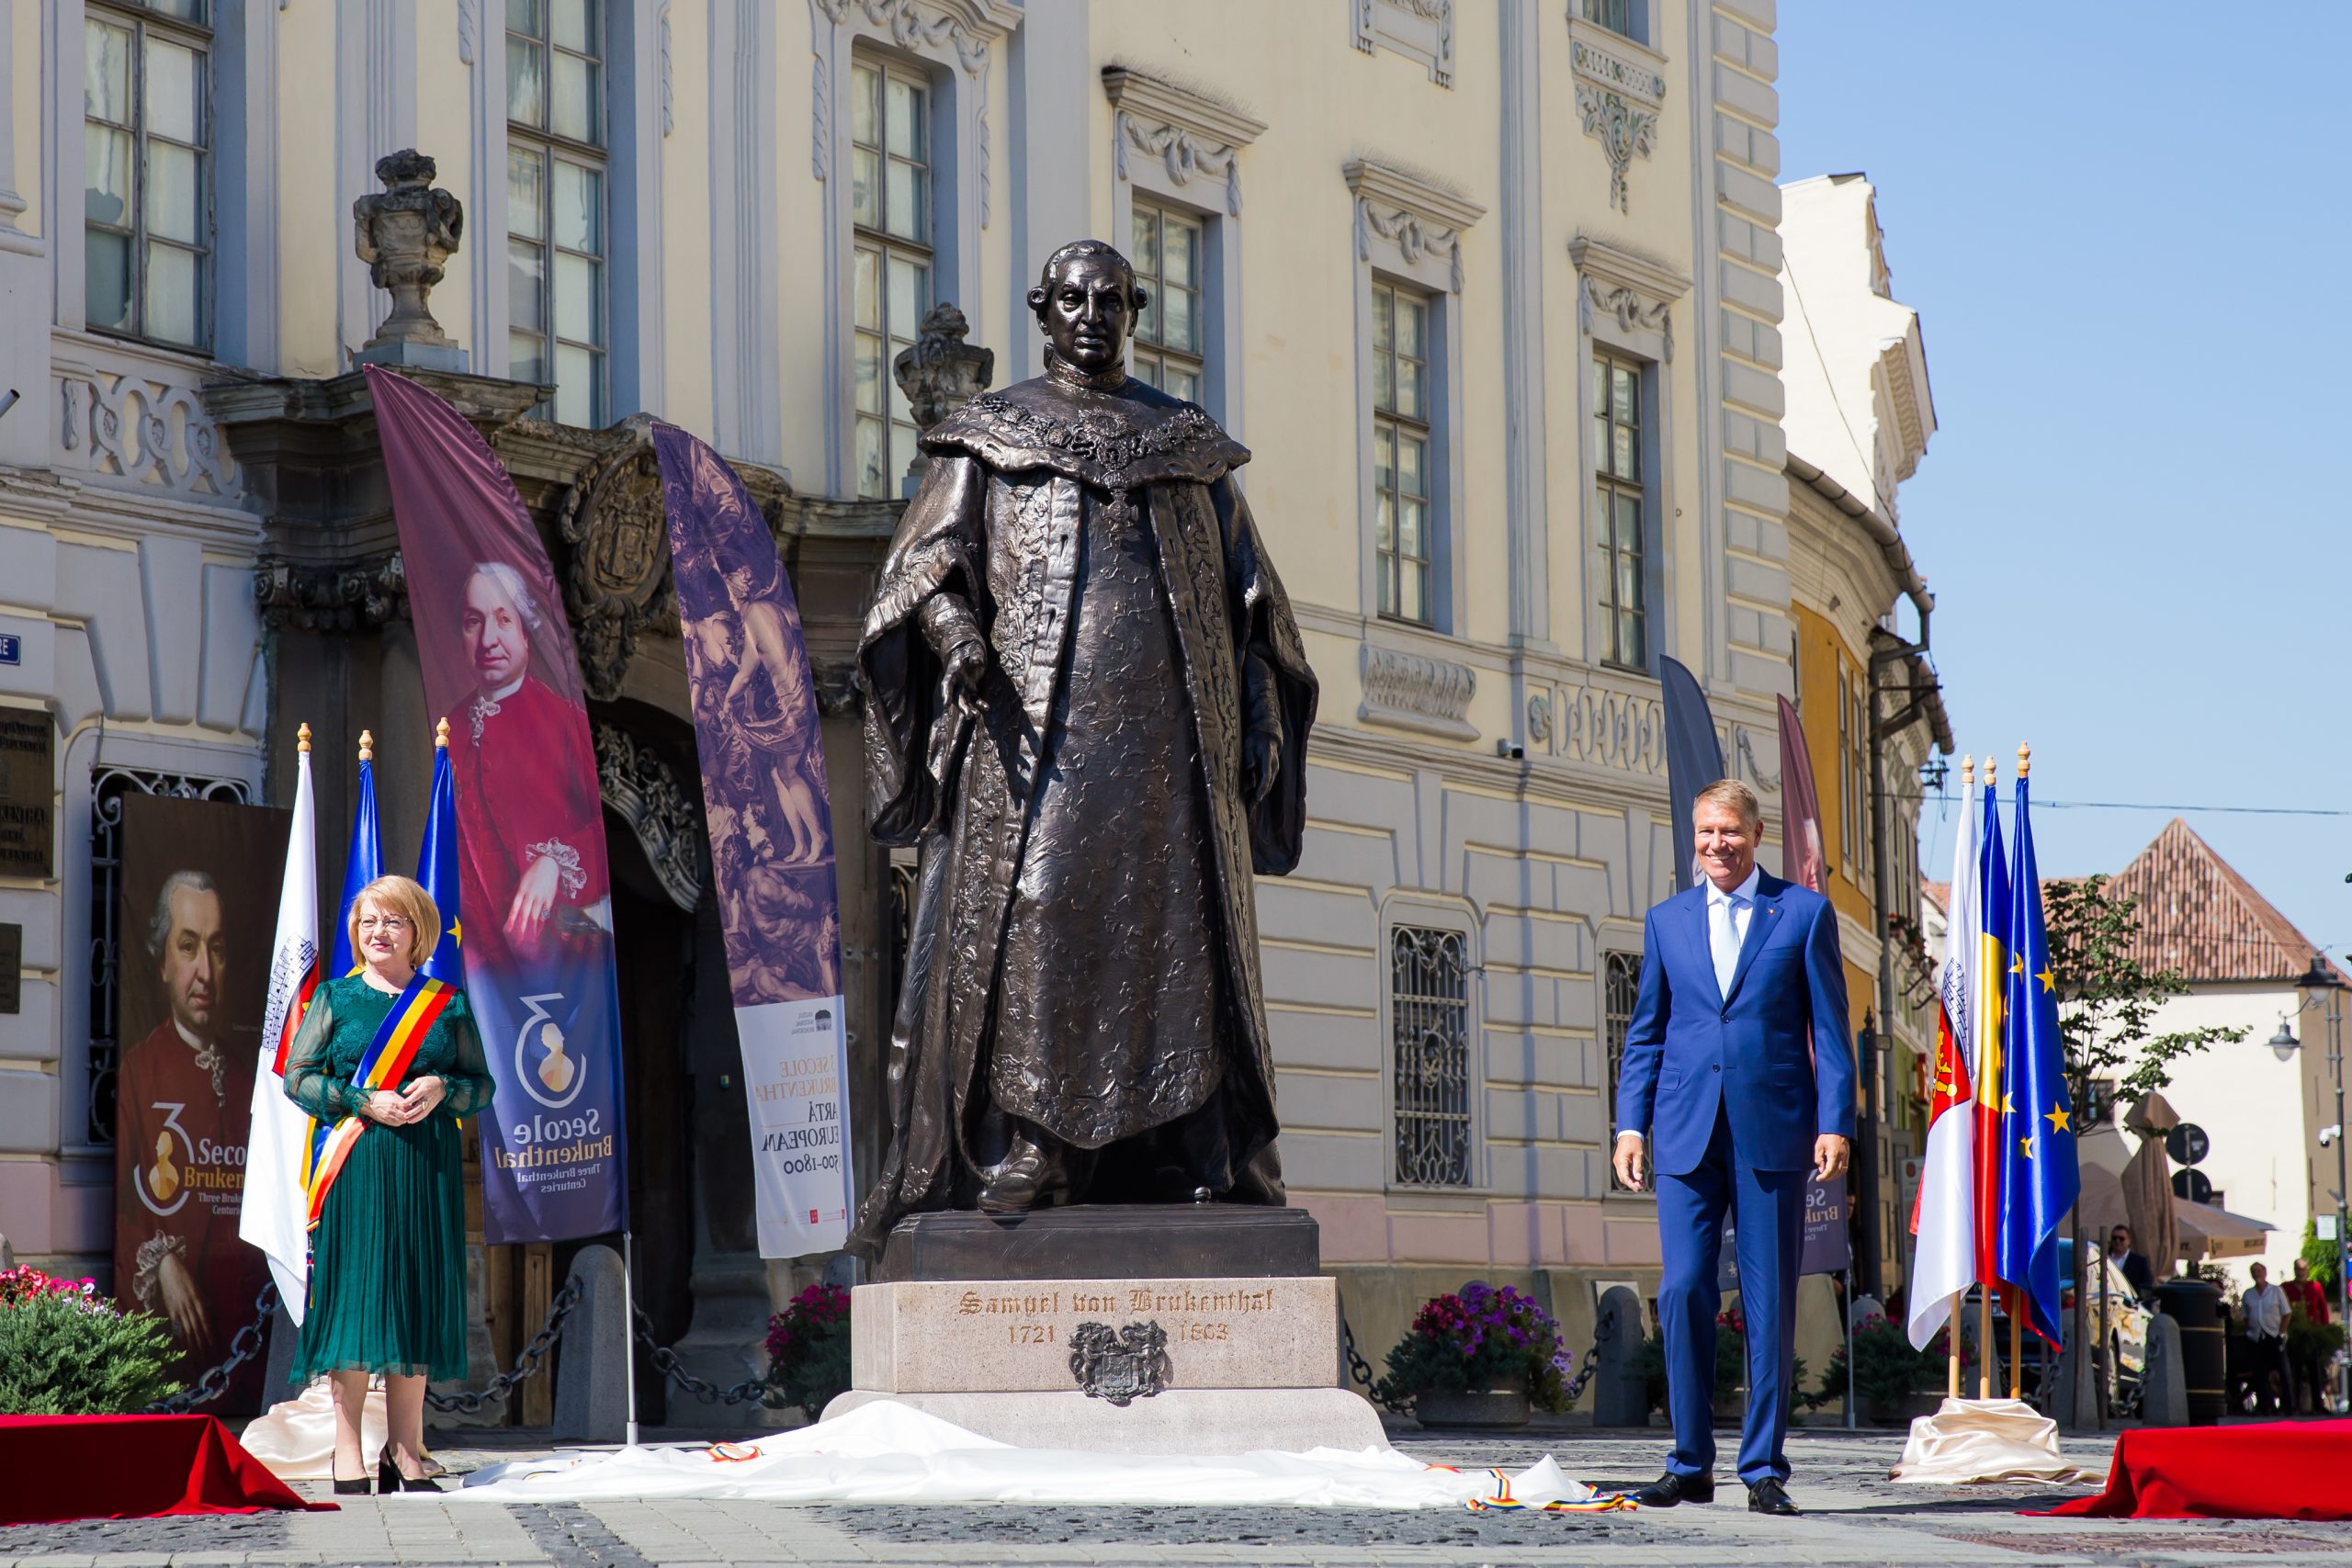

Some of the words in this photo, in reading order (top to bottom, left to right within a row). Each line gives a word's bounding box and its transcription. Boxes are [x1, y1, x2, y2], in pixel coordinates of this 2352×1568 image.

[198, 1138, 246, 1166] Seco
[198, 1192, 220, 1203] Three
[959, 1291, 1059, 1315] Samuel
[1072, 1292, 1117, 1313] von
[1129, 1288, 1274, 1315] Brukenthal
[1008, 1325, 1056, 1344] 1721
[1181, 1321, 1229, 1341] 1803
